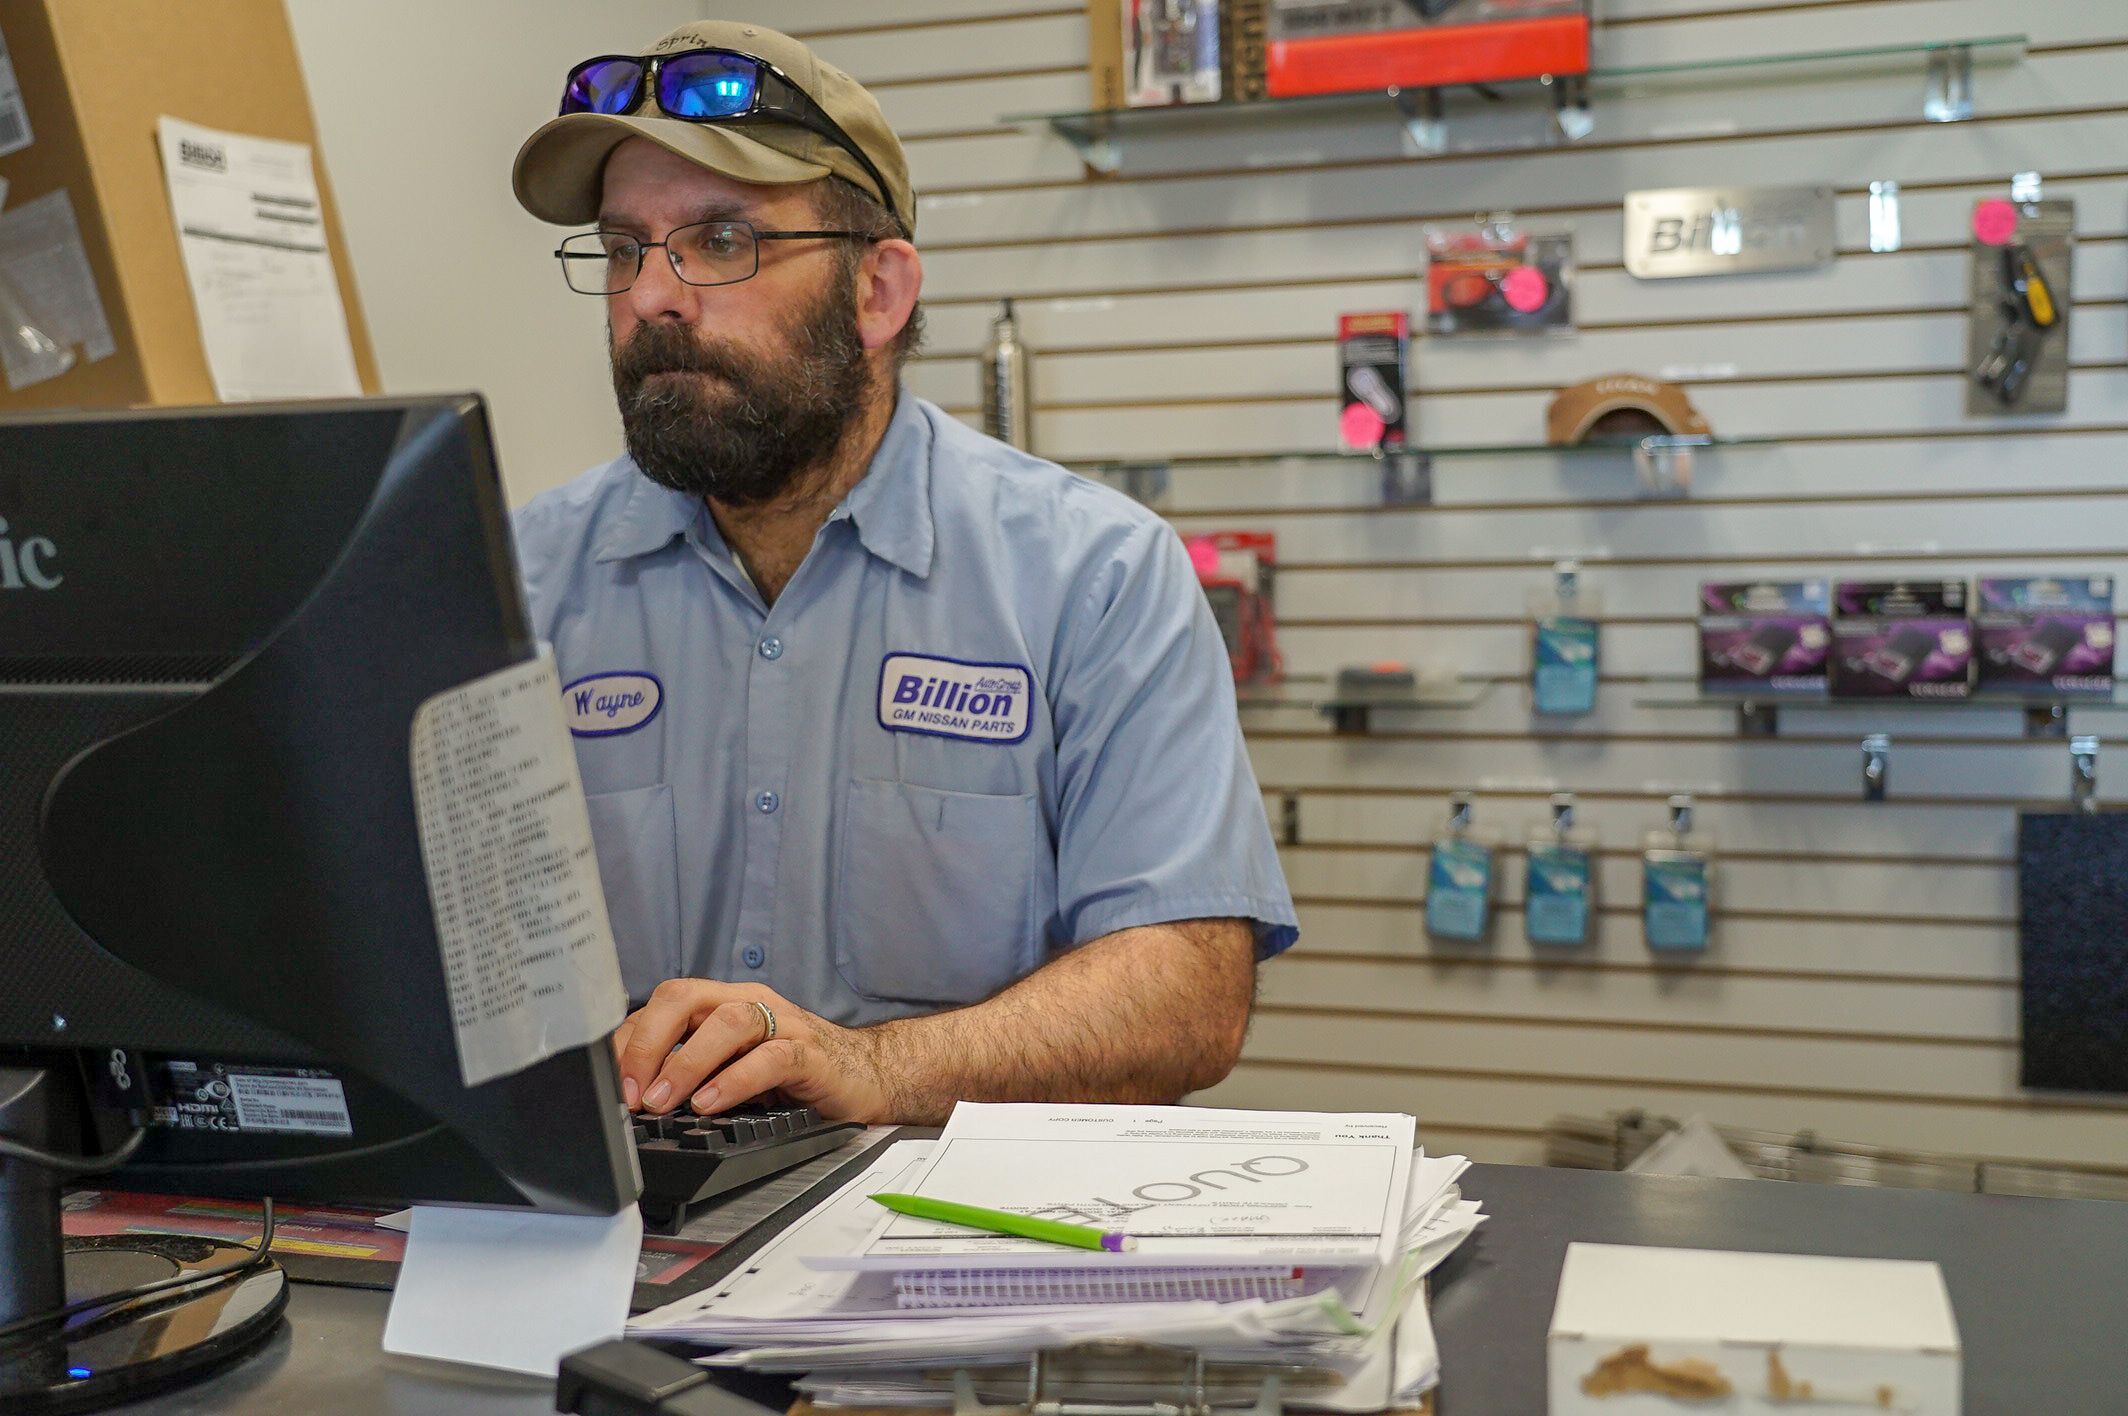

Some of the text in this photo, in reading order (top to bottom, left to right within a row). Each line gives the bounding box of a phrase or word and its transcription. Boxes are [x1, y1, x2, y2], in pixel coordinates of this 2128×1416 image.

[656, 33, 716, 50] Sprin
[574, 687, 645, 718] Wayne
[893, 674, 1013, 717] Billion
[893, 708, 1015, 733] GM NISSAN PARTS
